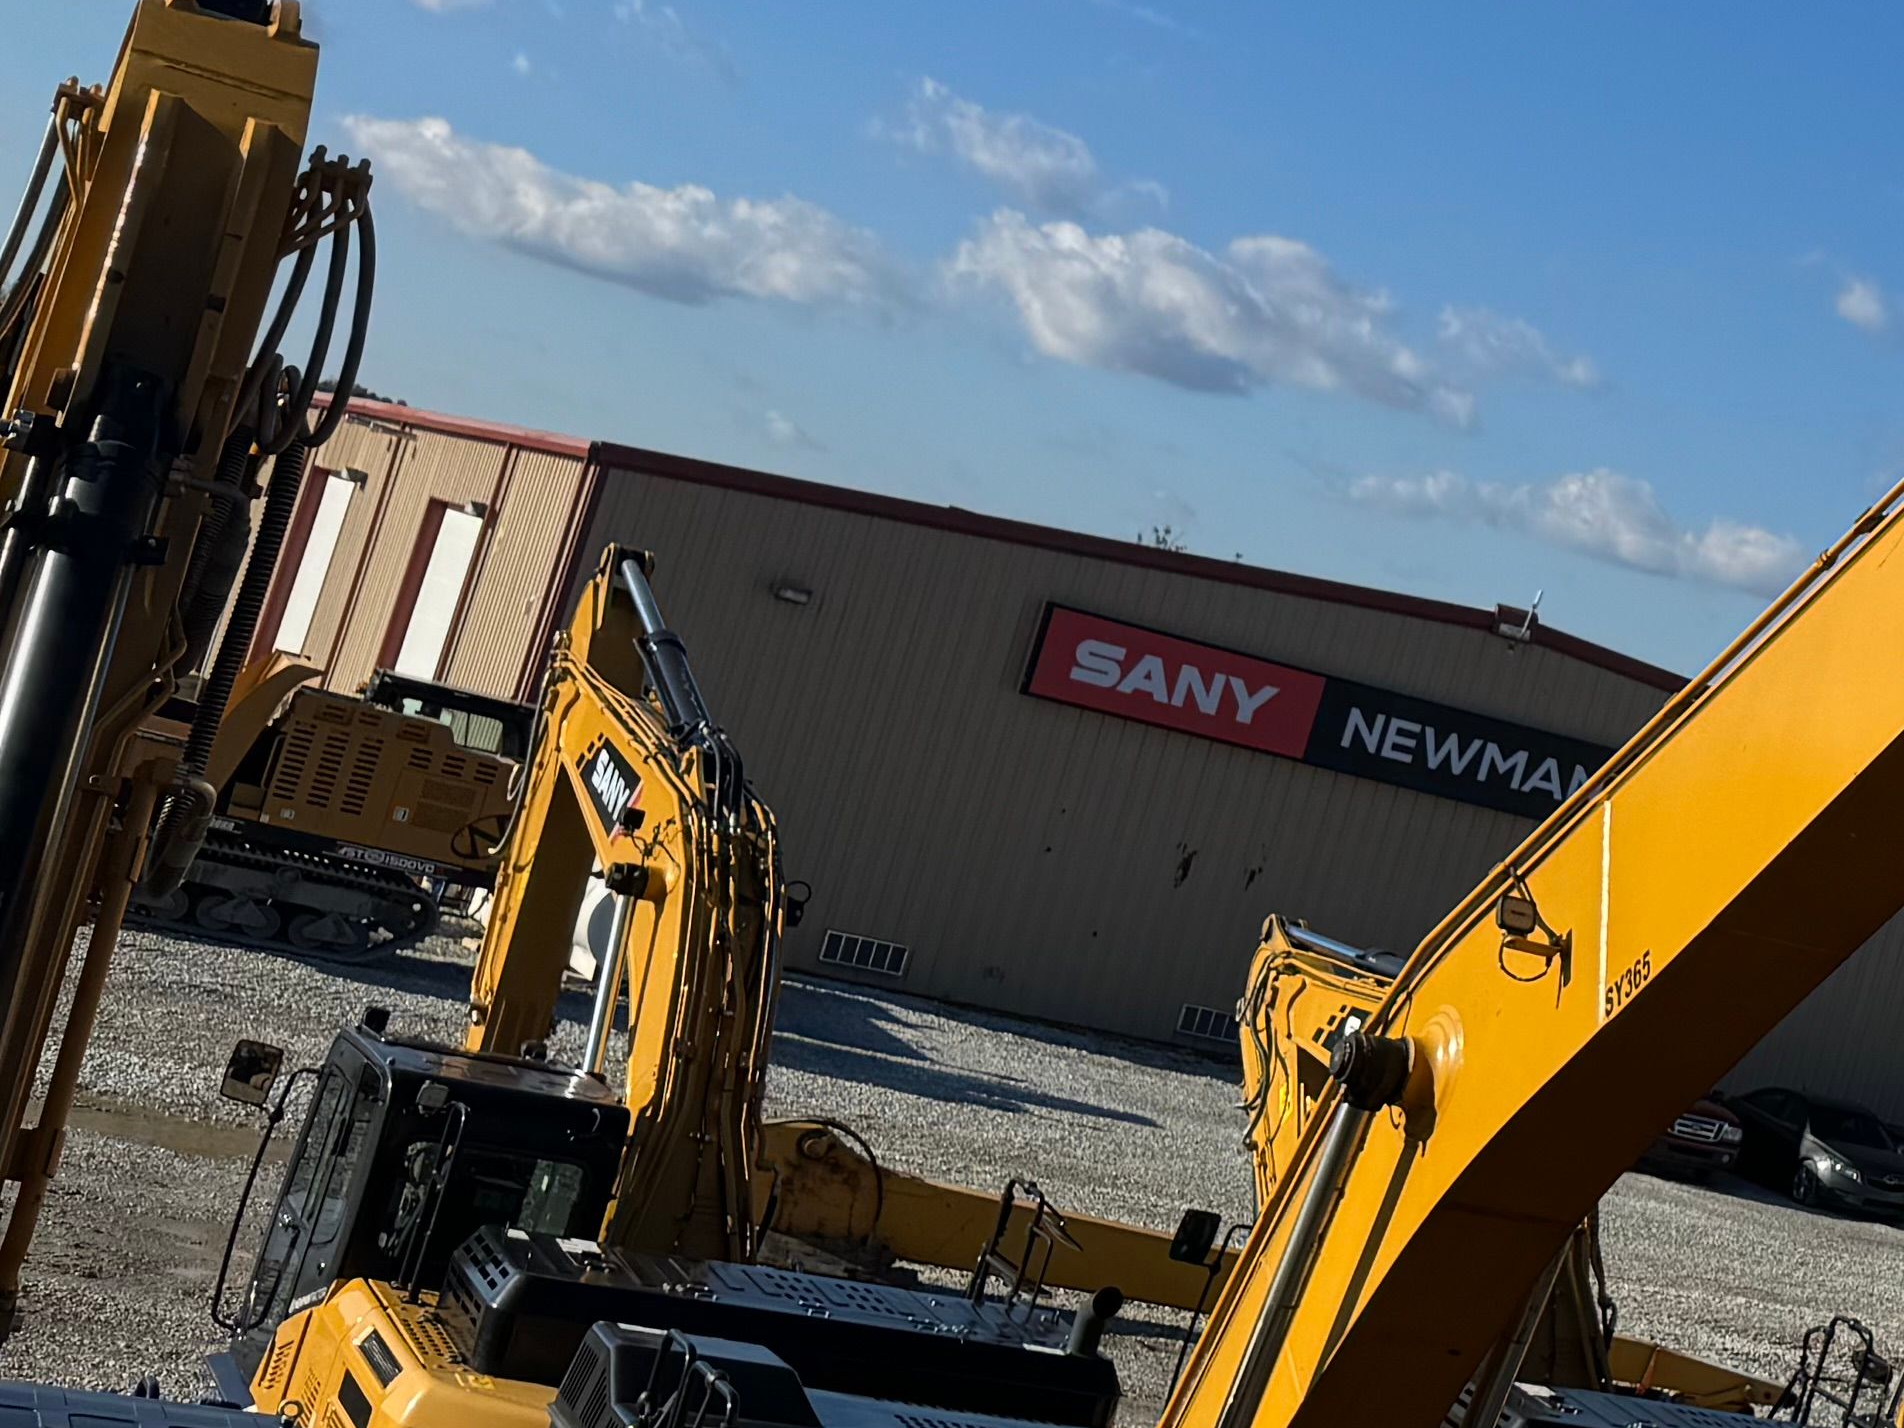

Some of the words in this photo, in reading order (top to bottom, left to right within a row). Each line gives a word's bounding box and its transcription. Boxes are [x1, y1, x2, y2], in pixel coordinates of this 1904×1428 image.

[1070, 638, 1280, 725] SANY
[592, 747, 631, 822] SANY
[1605, 948, 1651, 1019] SY365
